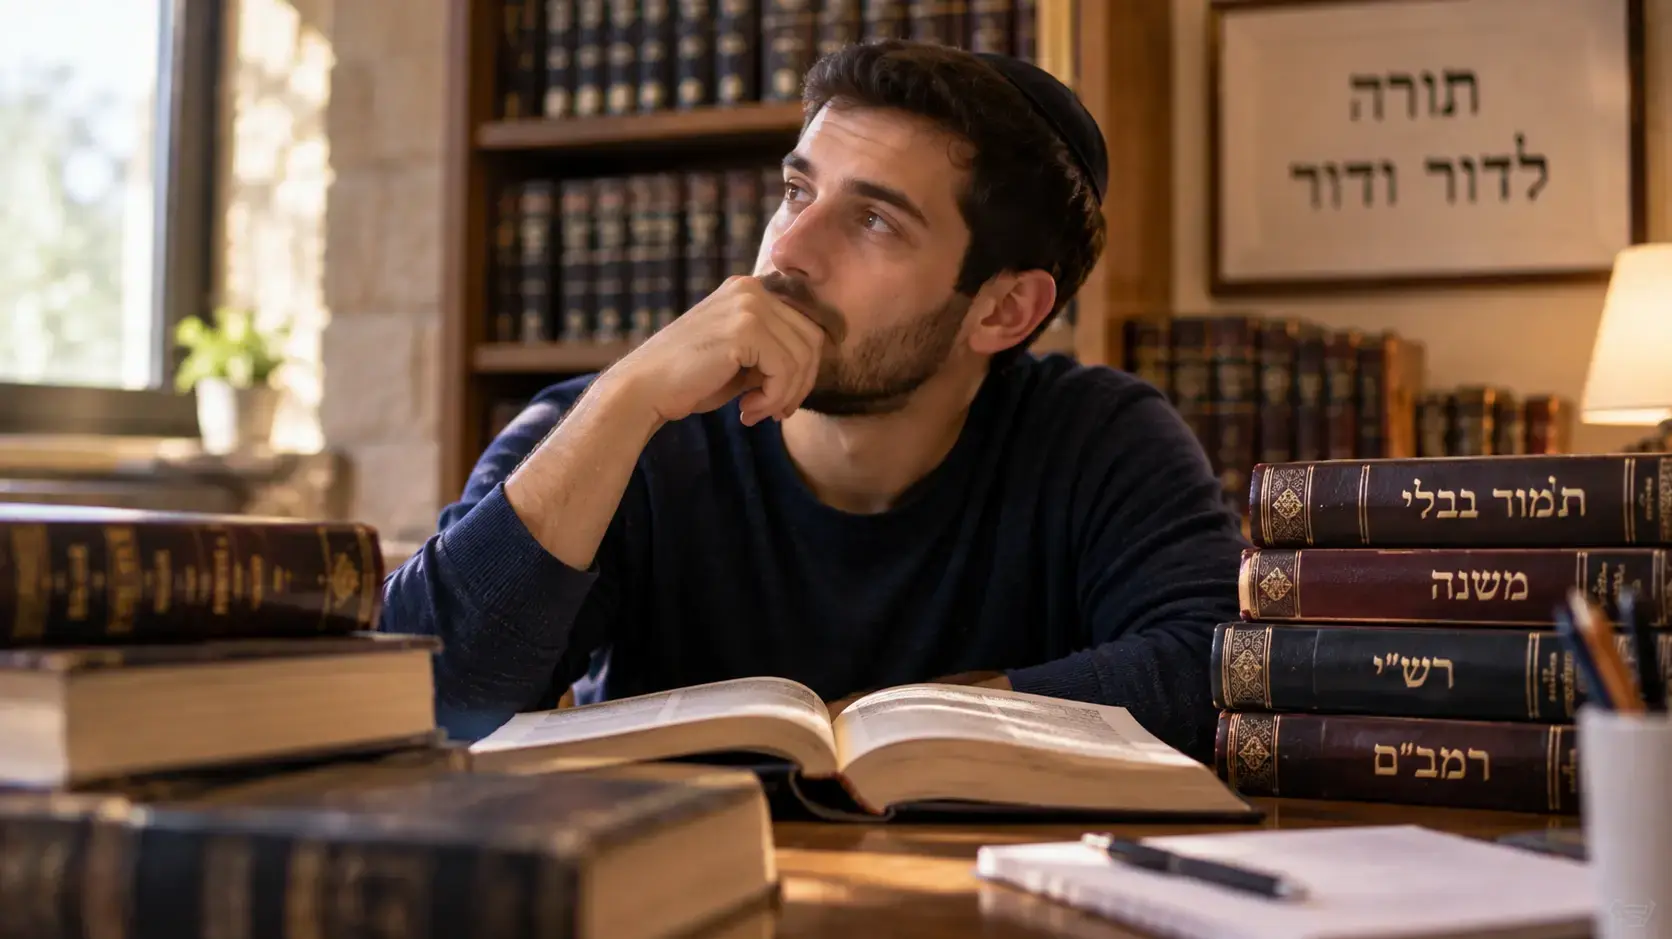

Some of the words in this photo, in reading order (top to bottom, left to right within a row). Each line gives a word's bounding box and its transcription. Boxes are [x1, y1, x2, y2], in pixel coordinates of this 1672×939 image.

[1349, 69, 1479, 121] תורה
[1290, 160, 1397, 210] ודור
[1423, 132, 1549, 204] לדור
[1401, 477, 1479, 520] בבלי
[1431, 569, 1529, 601] משנה
[1373, 652, 1454, 689] רש"י
[1373, 742, 1490, 782] רמב"ם
